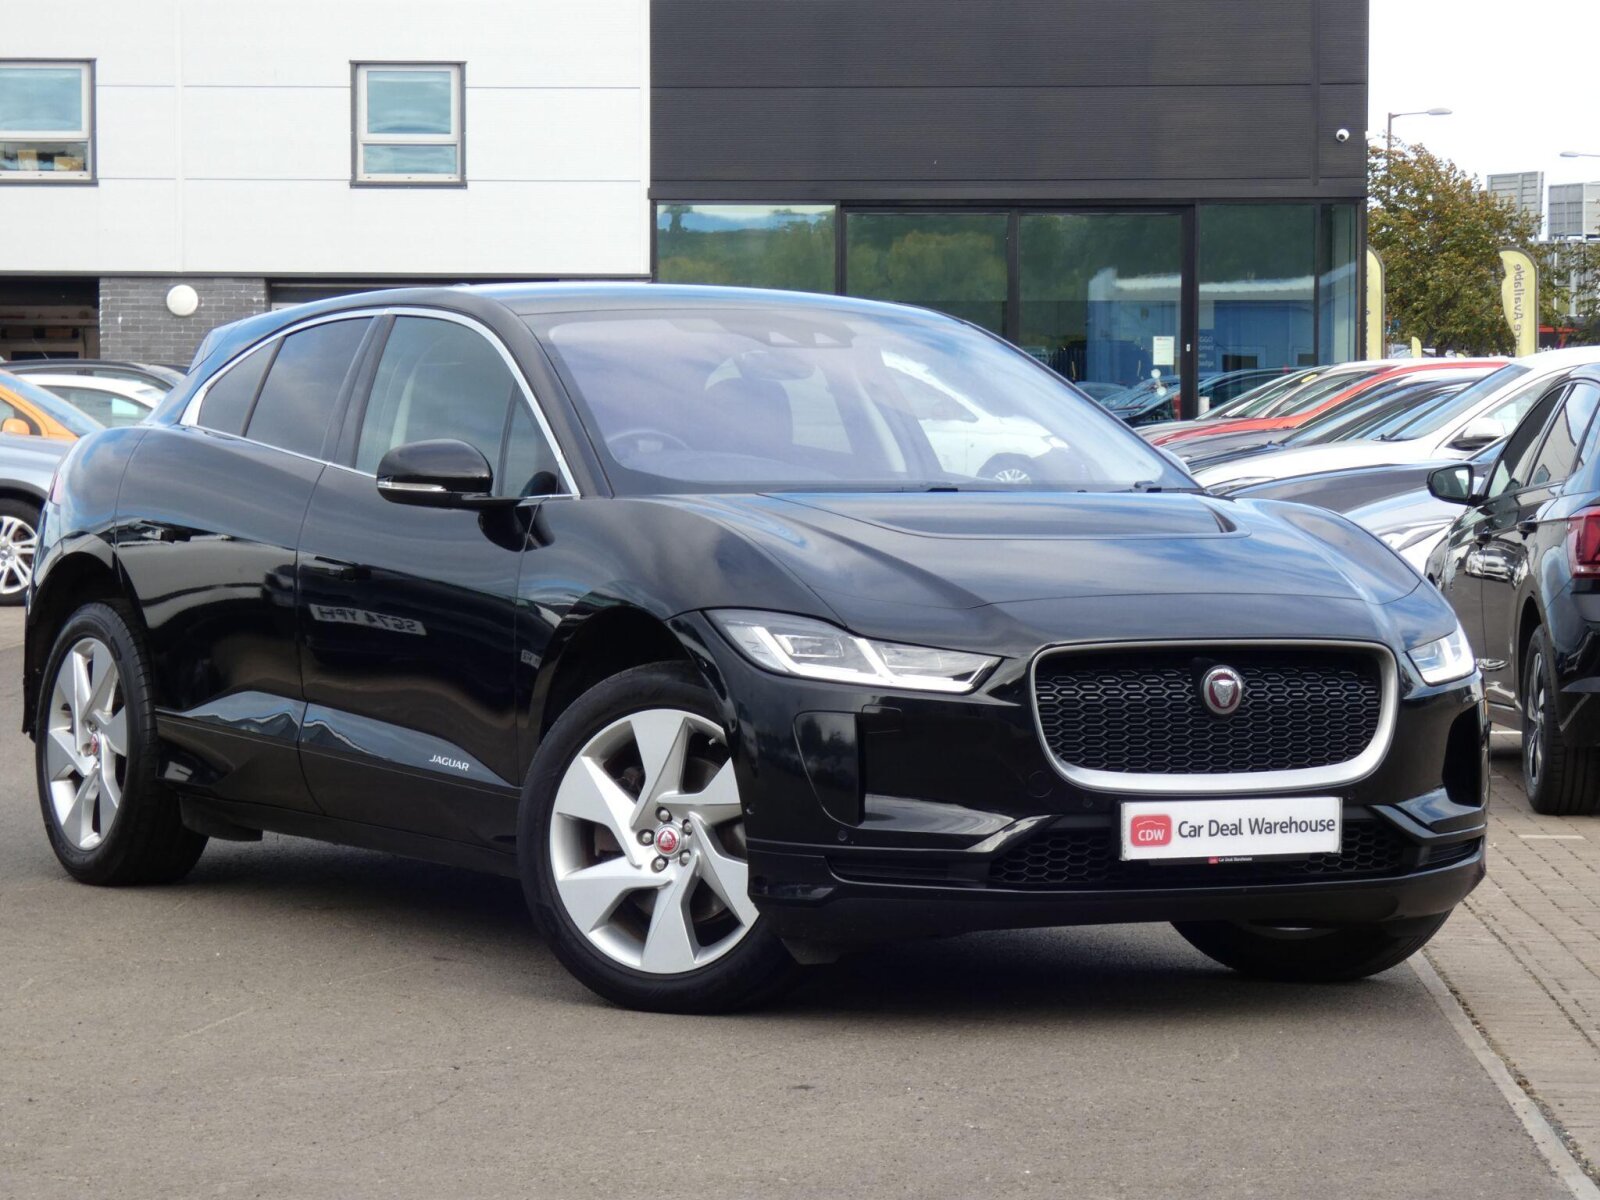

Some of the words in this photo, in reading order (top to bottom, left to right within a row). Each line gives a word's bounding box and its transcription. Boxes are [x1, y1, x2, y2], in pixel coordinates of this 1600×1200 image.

[429, 754, 470, 771] JAGUAR
[1137, 829, 1165, 842] CDW
[1177, 820, 1204, 838] Car
[1208, 817, 1244, 838] Deal
[1248, 816, 1336, 836] Warehouse
